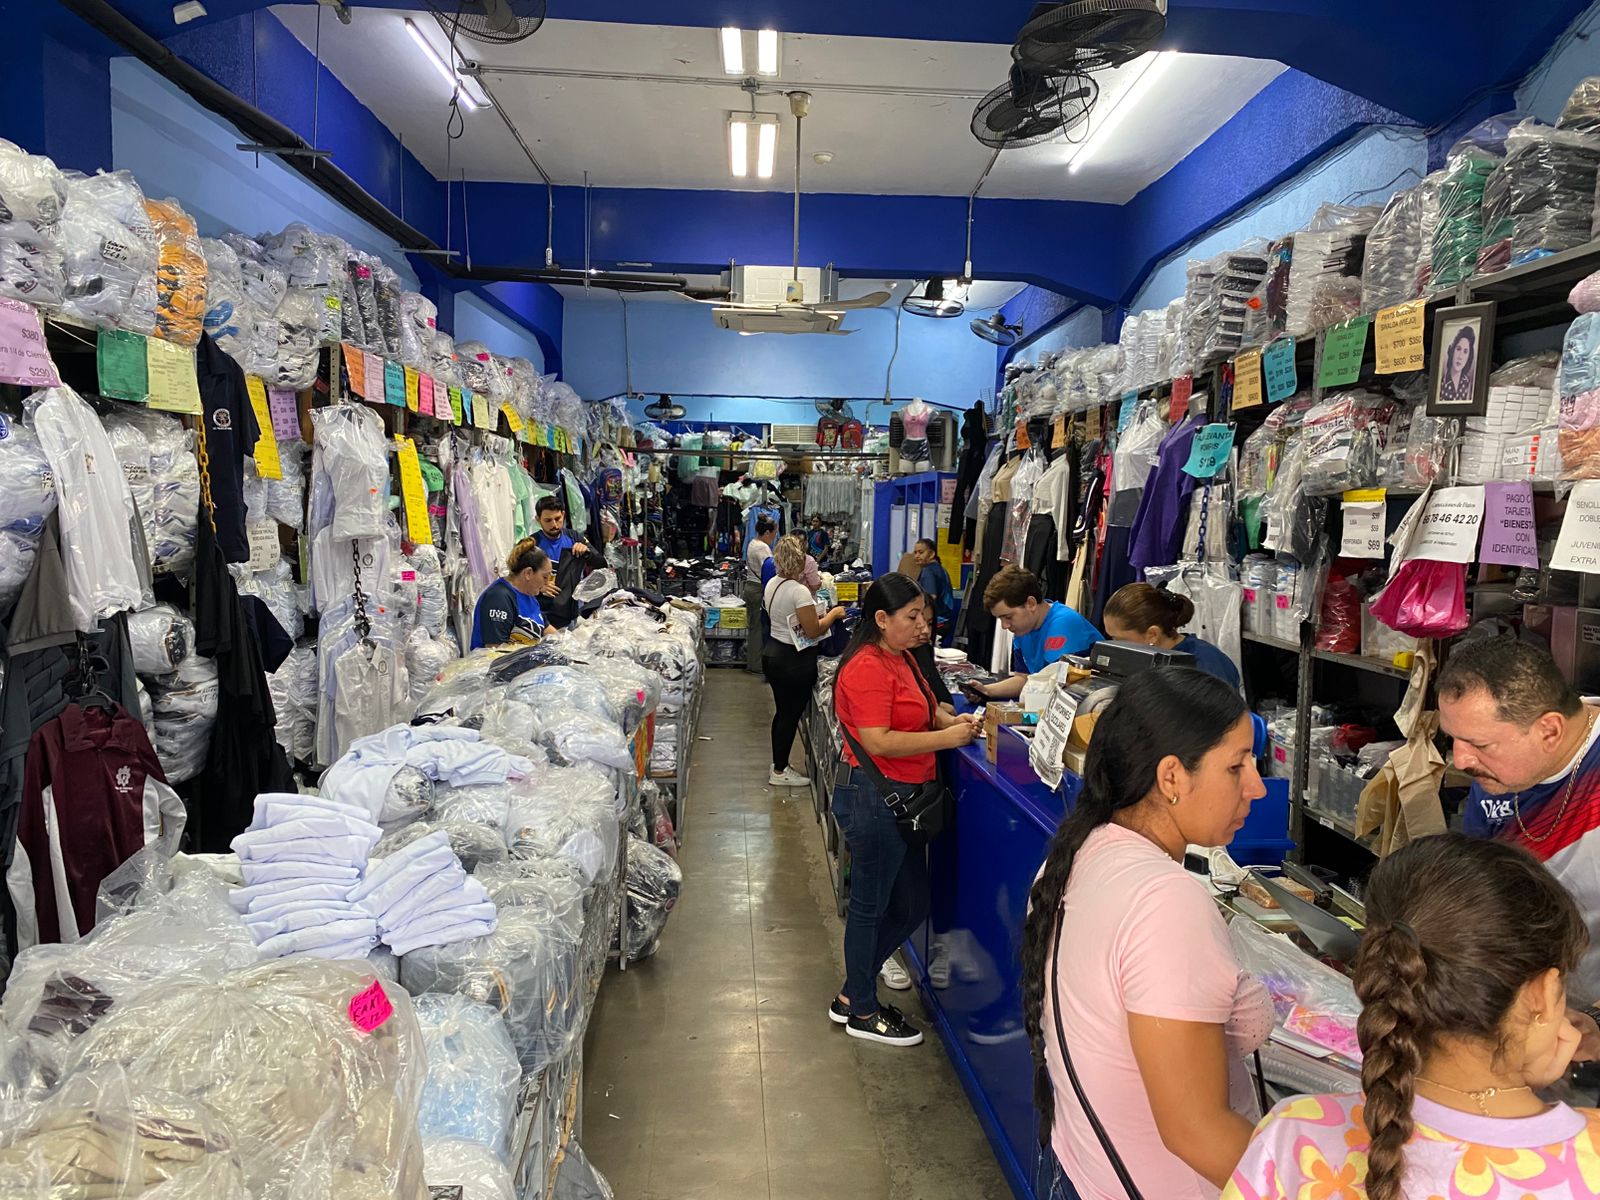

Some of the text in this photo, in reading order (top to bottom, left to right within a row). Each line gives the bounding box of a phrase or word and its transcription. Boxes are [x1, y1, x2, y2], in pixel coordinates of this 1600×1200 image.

[21, 328, 39, 341] $380
[29, 366, 51, 378] $290
[1506, 493, 1524, 504] PAGO
[1504, 506, 1531, 516] TARJETA
[1515, 532, 1530, 543] CON
[1570, 555, 1597, 565] EXTRA
